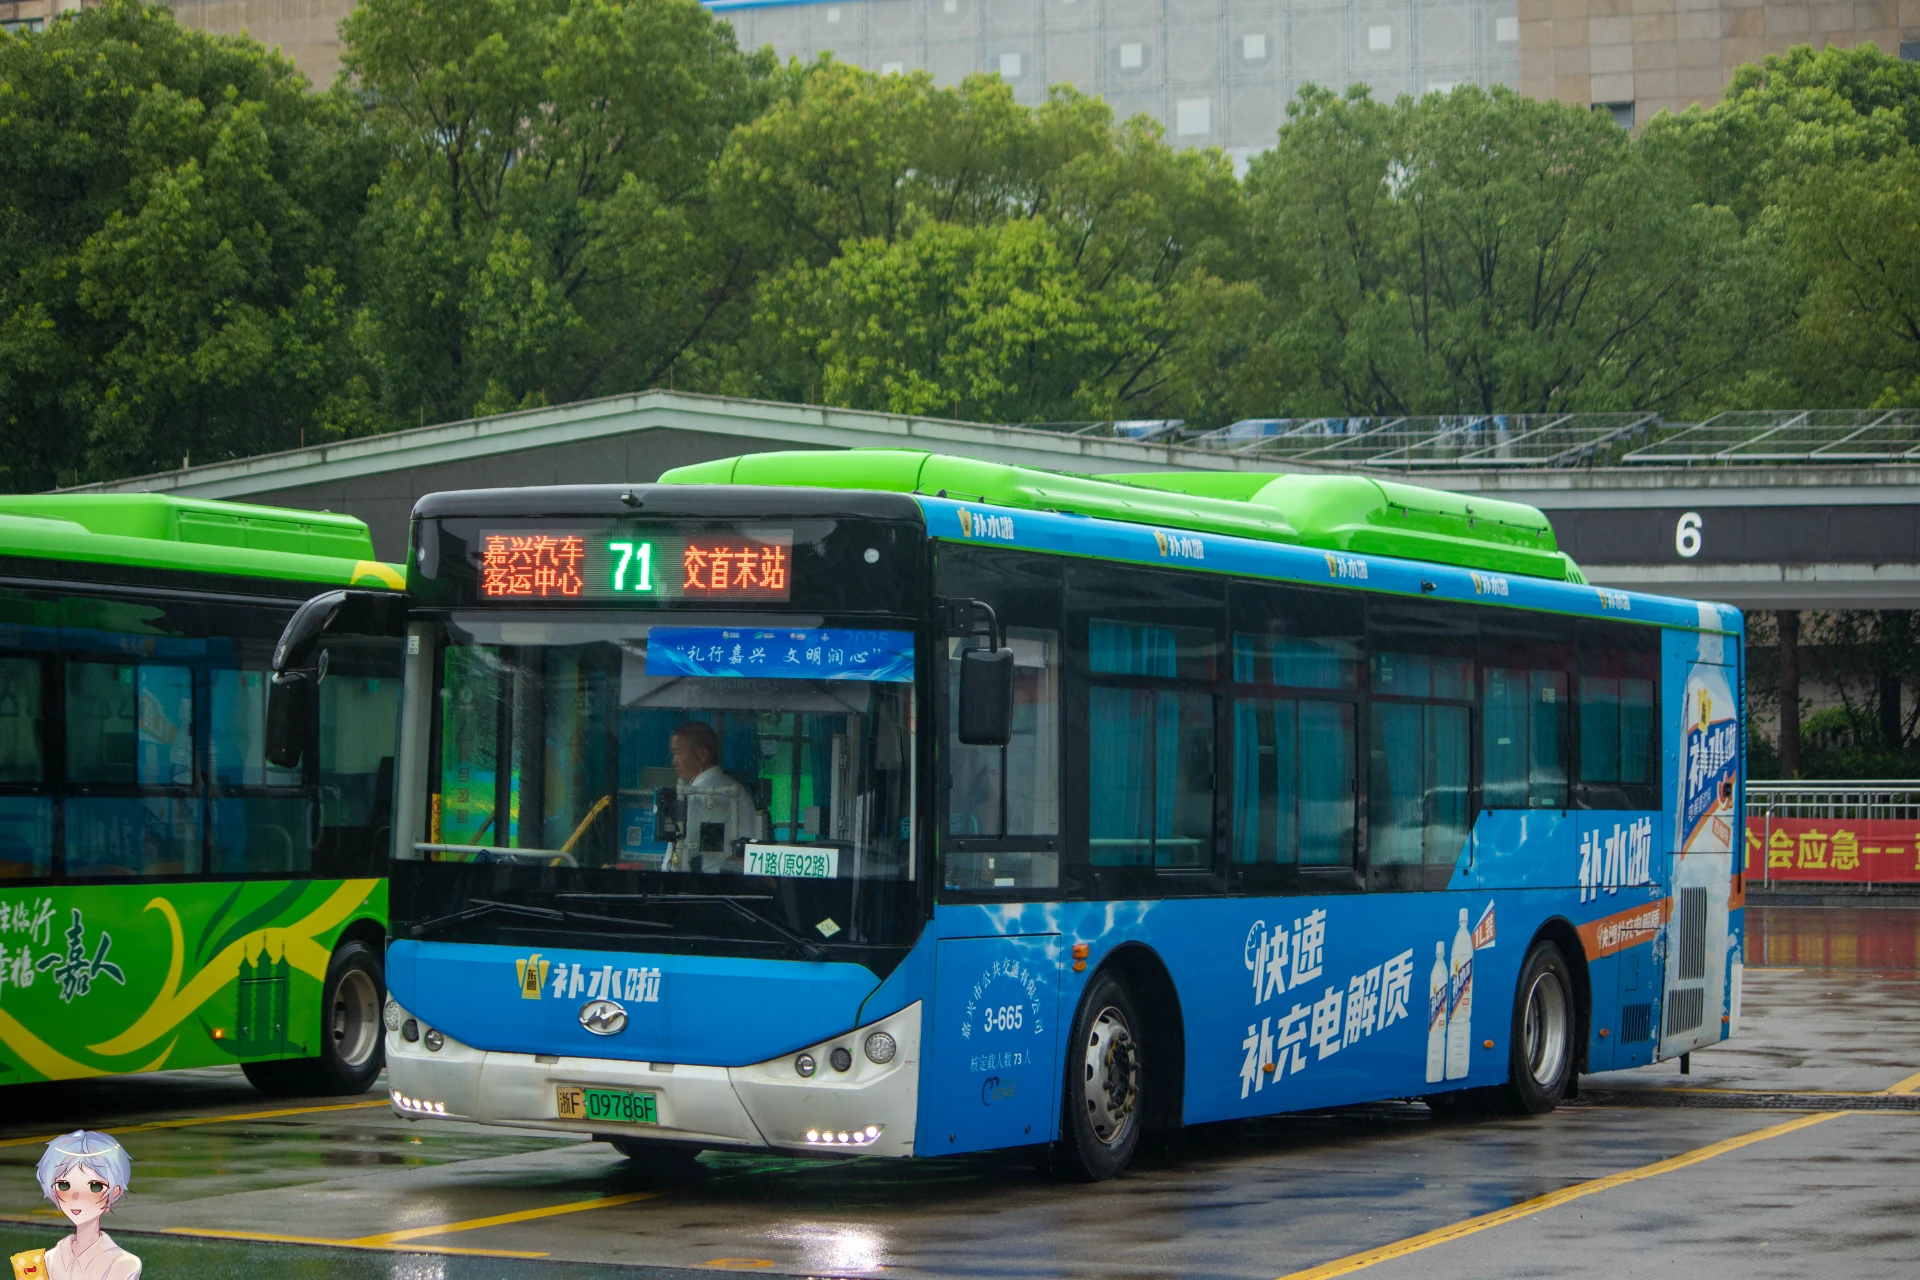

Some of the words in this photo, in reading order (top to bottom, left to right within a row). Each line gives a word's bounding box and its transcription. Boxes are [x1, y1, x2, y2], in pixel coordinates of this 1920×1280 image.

[973, 514, 1014, 540] 补水啦
[1676, 511, 1702, 558] 6
[482, 535, 584, 566] 嘉兴汽车
[1168, 535, 1204, 559] 补水啦
[482, 565, 583, 596] 客运中心
[609, 542, 652, 591] 71
[683, 545, 786, 590] 交首末站
[1337, 557, 1368, 580] 补水啦
[1482, 575, 1509, 597] 补水啦
[1579, 816, 1652, 905] 补水啦
[1245, 909, 1327, 1006] 快速
[552, 963, 661, 1002] 补水啦
[984, 1005, 1022, 1032] 3-665
[1240, 948, 1413, 1099] 补充电解质
